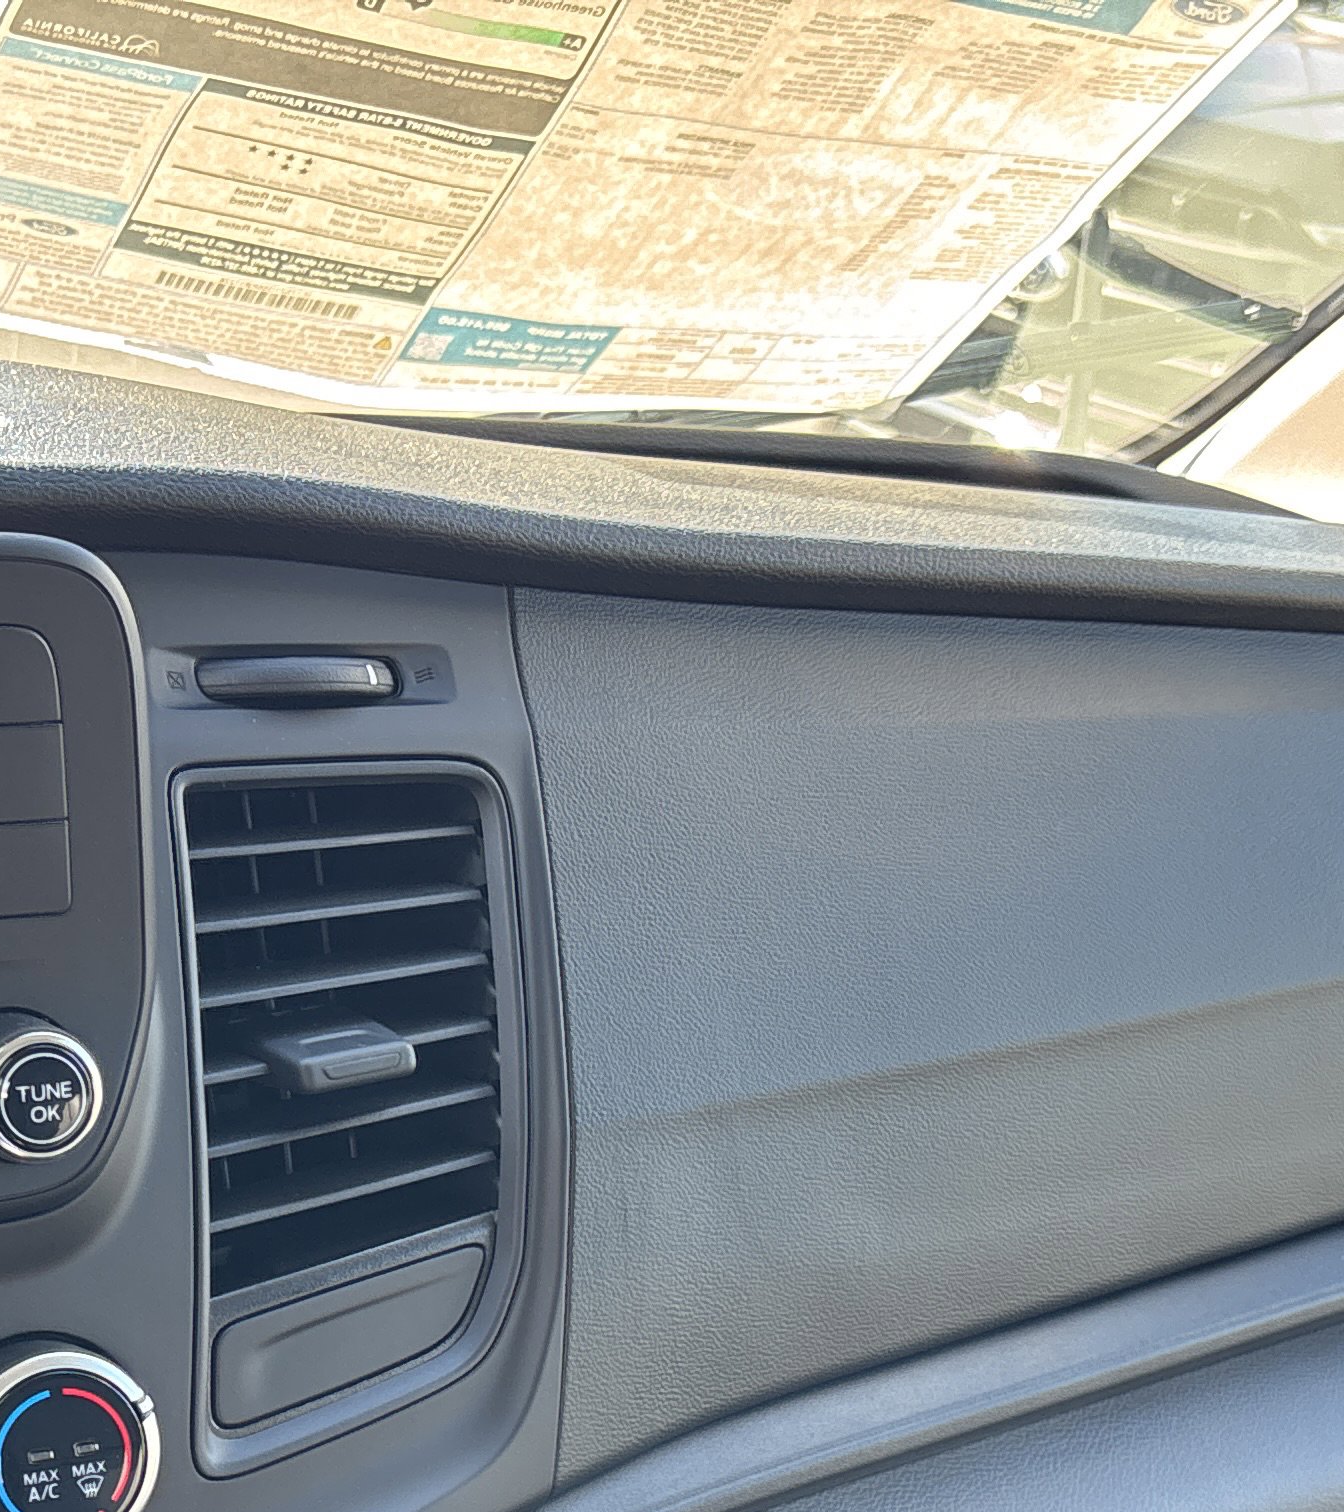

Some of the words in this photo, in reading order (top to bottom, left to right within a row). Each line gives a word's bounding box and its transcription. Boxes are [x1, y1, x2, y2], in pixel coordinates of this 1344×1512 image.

[15, 1081, 72, 1103] TUNE
[30, 1104, 61, 1124] OK
[23, 1469, 60, 1486] MAX
[72, 1461, 107, 1477] MAX
[28, 1483, 60, 1503] A/C
